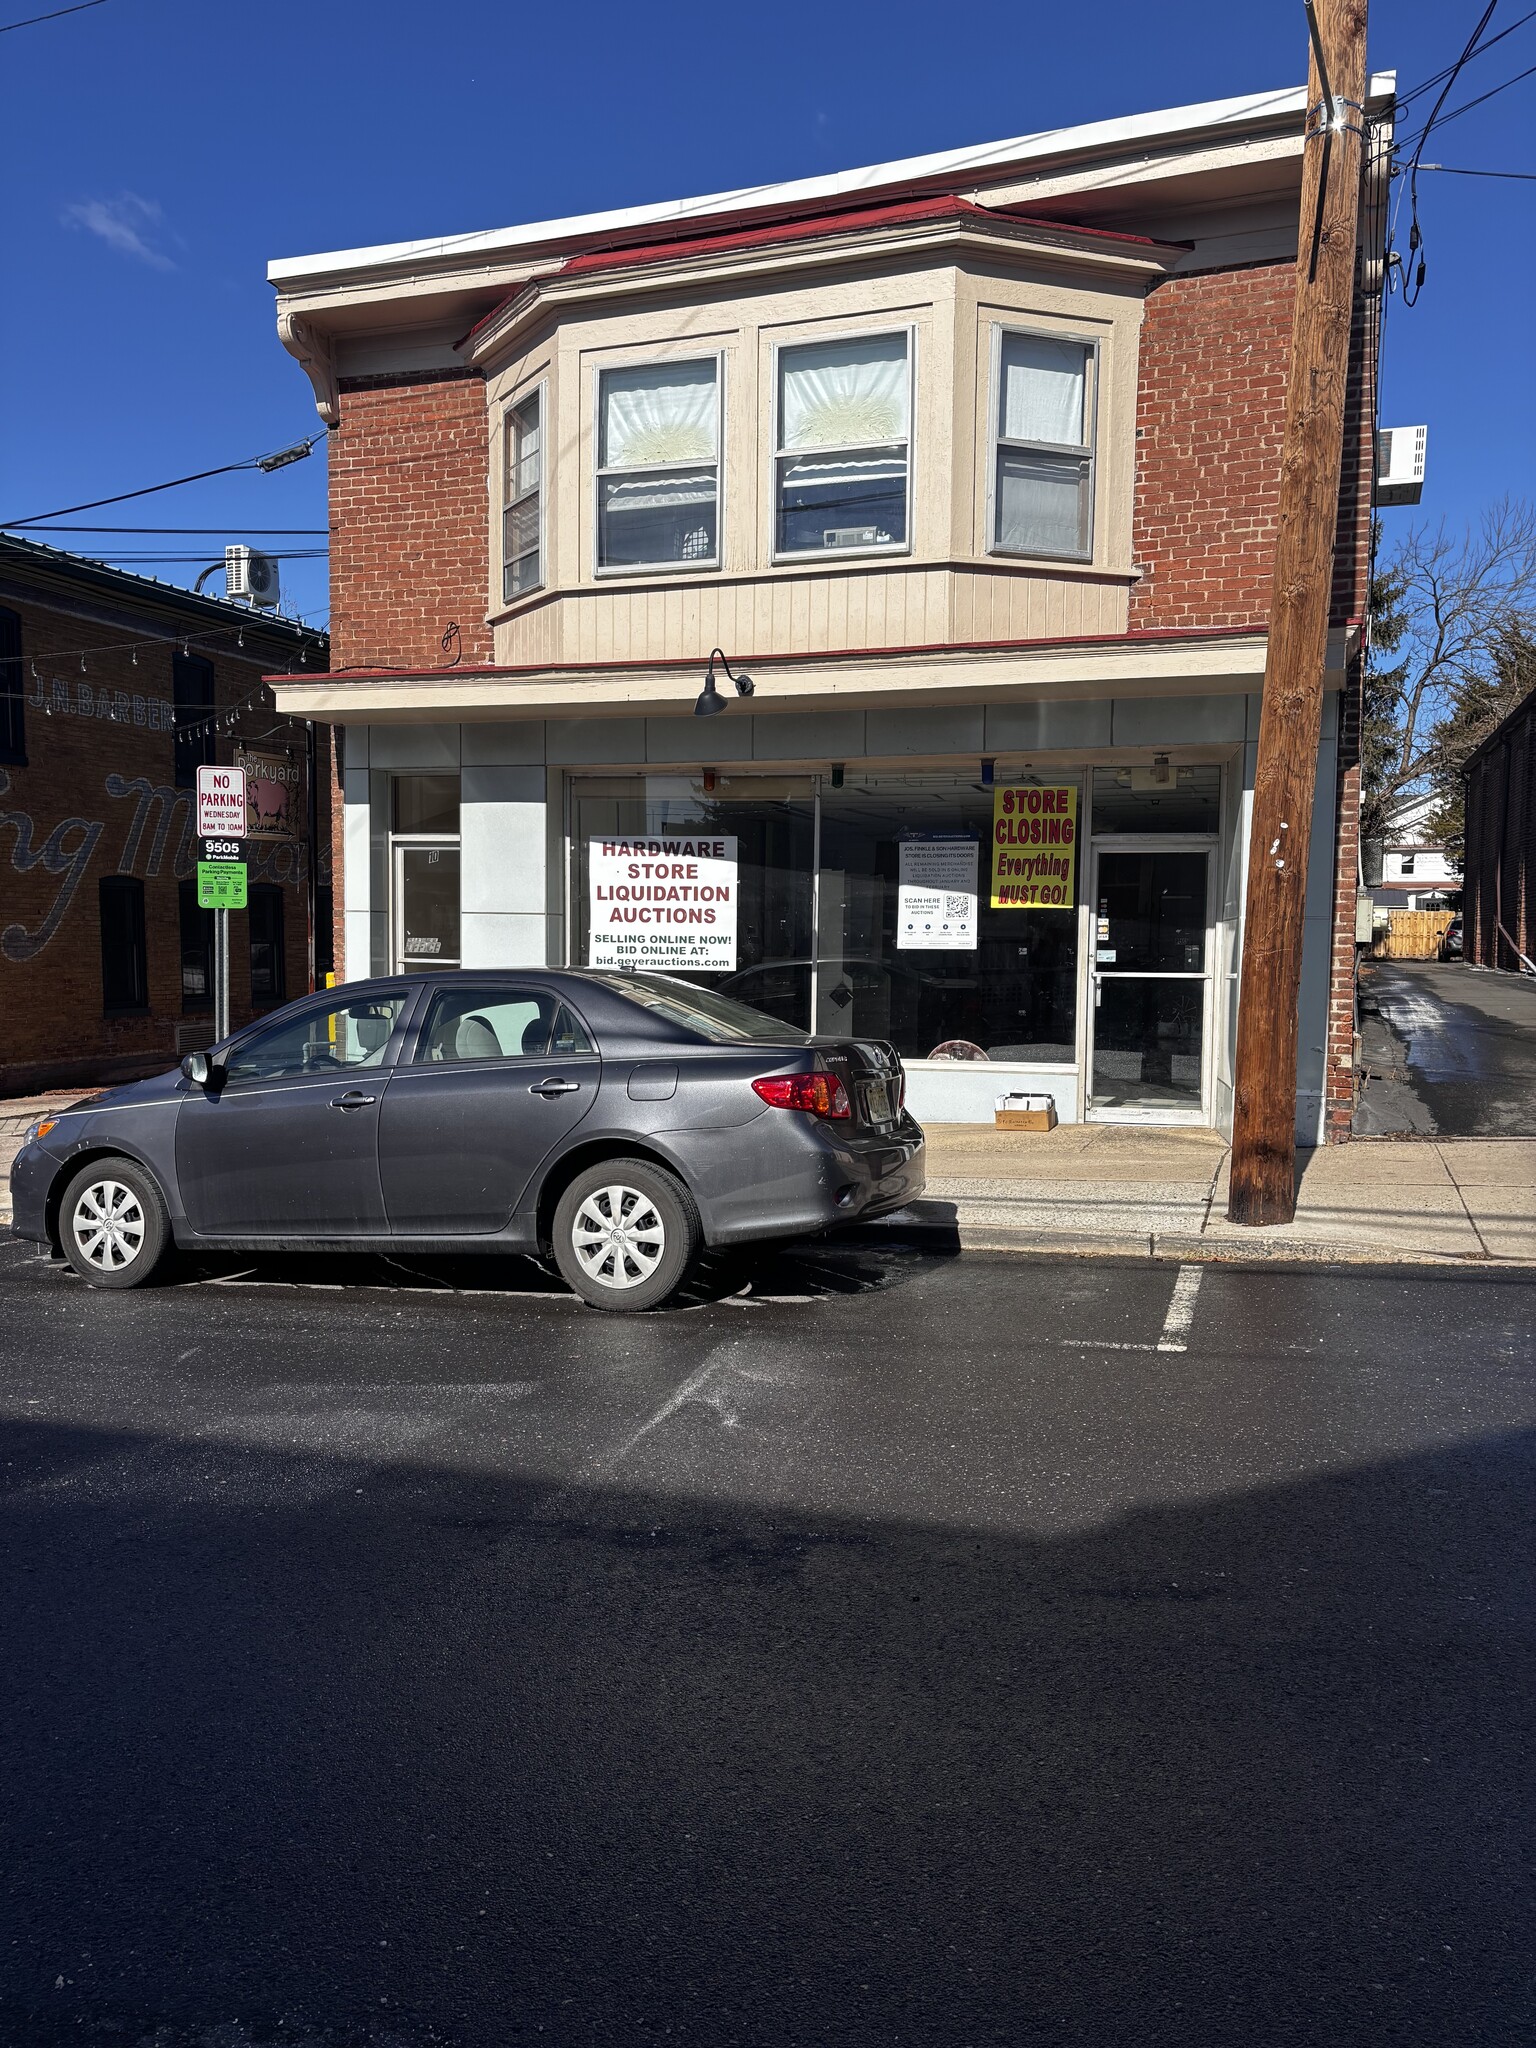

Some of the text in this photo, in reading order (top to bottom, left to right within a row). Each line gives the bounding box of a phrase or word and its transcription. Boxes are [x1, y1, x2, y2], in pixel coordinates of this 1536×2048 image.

[246, 752, 258, 762] The
[237, 757, 299, 784] Porkyard
[213, 775, 230, 788] NO
[201, 793, 243, 807] PARKING
[1002, 789, 1068, 814] STORE
[204, 810, 240, 818] WEDNESDAY
[995, 818, 1074, 844] CLOSING
[205, 842, 239, 853] 9505
[602, 841, 725, 857] HARDWARE
[628, 863, 698, 879] STORE
[997, 852, 1070, 881] Everything
[596, 885, 730, 902] LIQUIDATION
[998, 885, 1067, 905] MUST GO!
[609, 907, 717, 924] AUCTIONS
[594, 934, 732, 945] SELLING ONLINE NOW!
[616, 946, 709, 955] BID ONLINE AT:
[596, 956, 730, 968] bid.geyerauctions.com
